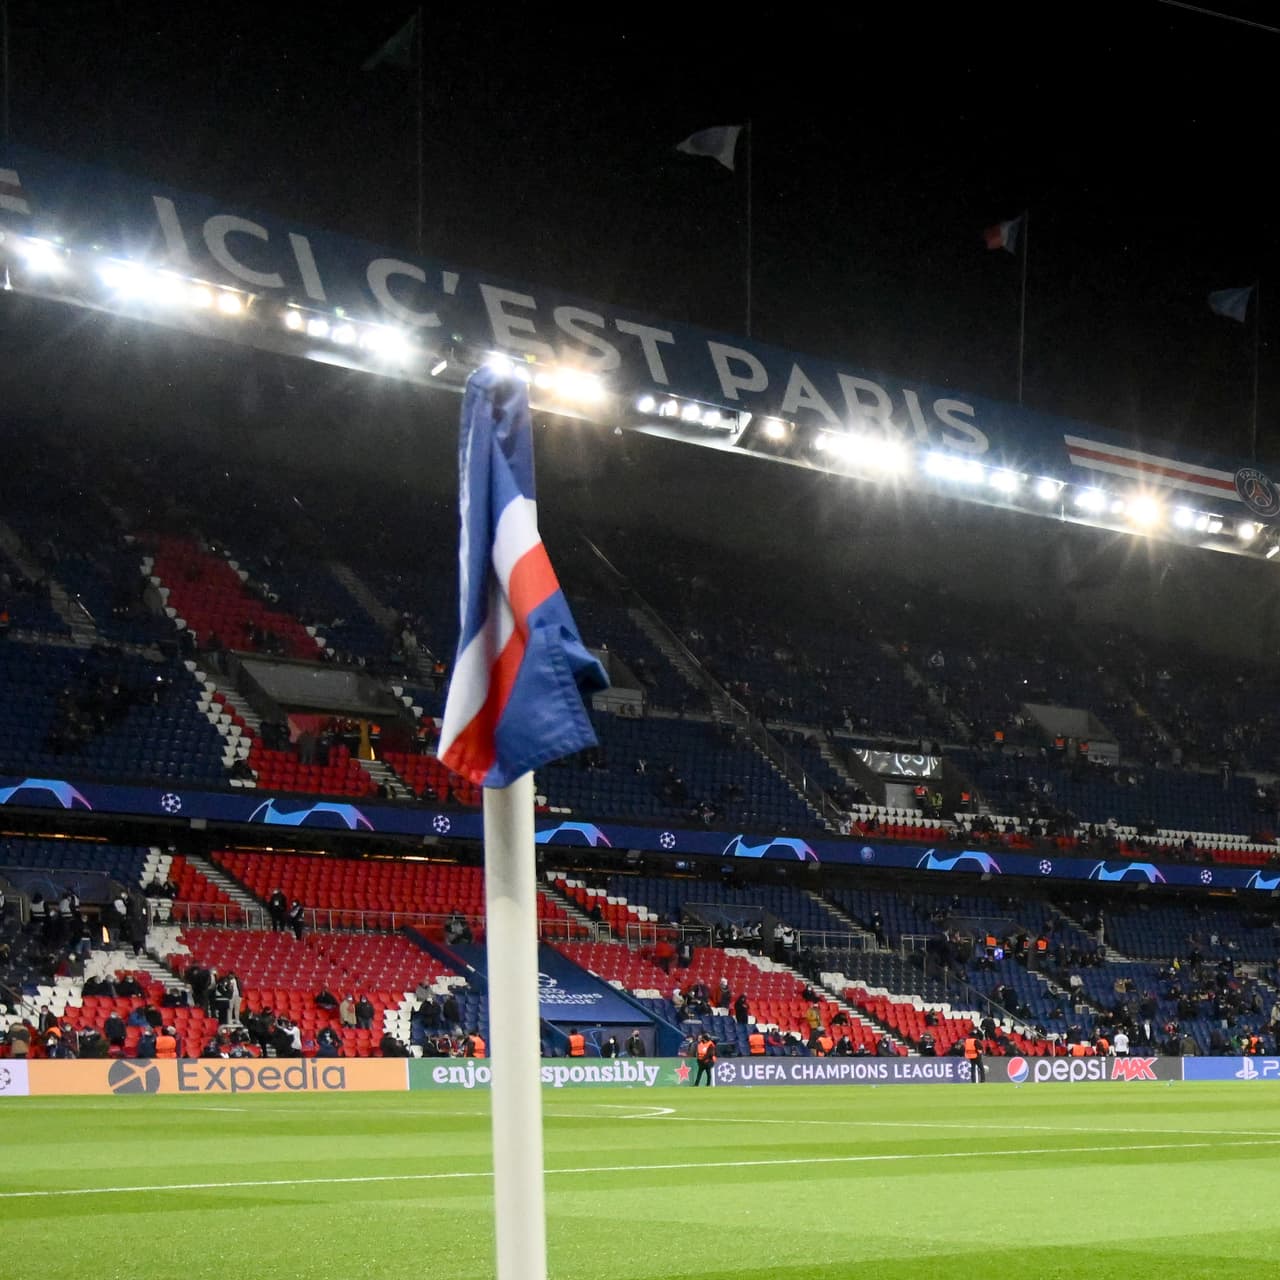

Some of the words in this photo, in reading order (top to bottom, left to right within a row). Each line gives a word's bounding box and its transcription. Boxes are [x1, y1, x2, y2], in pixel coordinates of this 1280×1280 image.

[153, 196, 326, 301] ICI
[366, 257, 675, 386] C'EST
[708, 340, 989, 454] PARIS
[178, 1059, 346, 1093] Expedia
[433, 1061, 491, 1088] enjo
[541, 1060, 660, 1088] sponsibly
[741, 1064, 787, 1080] UEFA
[791, 1063, 889, 1080] CHAMPIONS
[894, 1063, 954, 1079] LEAGUE
[1034, 1057, 1107, 1083] pepsi
[1111, 1057, 1159, 1081] MAX
